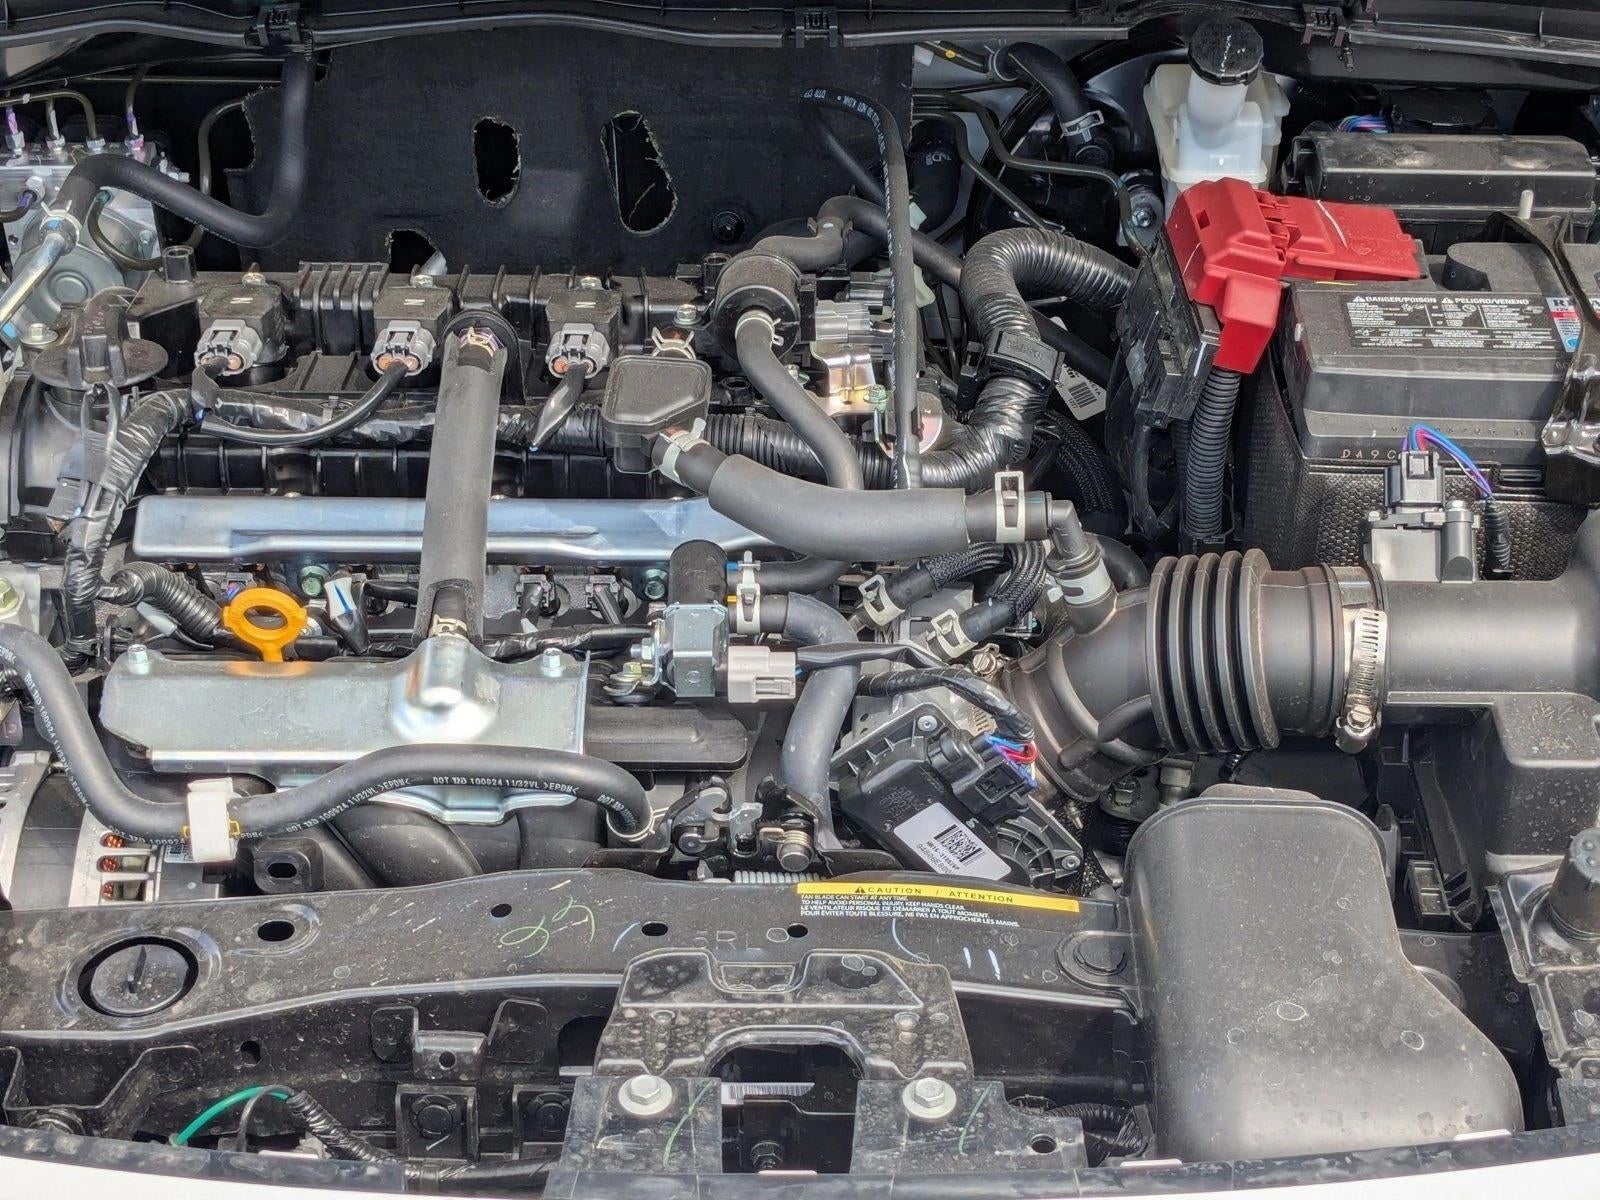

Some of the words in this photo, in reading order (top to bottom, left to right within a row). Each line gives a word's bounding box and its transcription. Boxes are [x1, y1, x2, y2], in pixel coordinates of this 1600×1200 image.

[1454, 297, 1530, 305] PELIGRO/VENENO
[433, 776, 449, 784] DOT
[949, 891, 1013, 903] ATTENTION
[940, 914, 982, 923] APPROCHER
